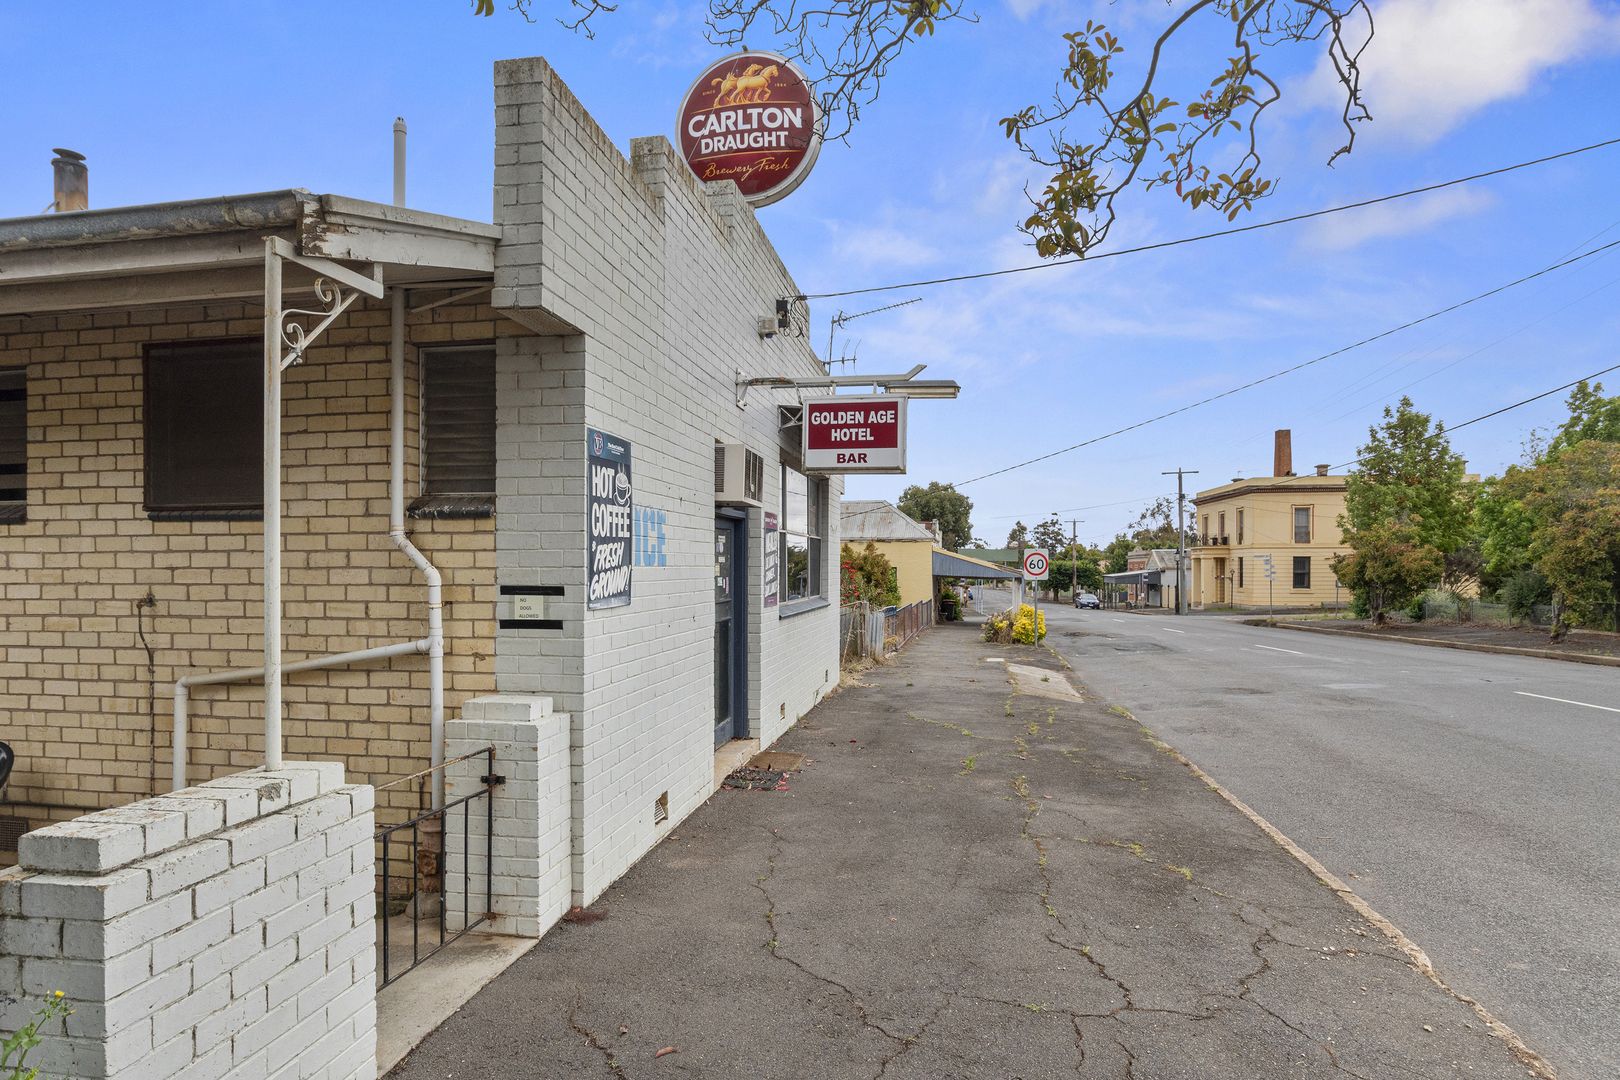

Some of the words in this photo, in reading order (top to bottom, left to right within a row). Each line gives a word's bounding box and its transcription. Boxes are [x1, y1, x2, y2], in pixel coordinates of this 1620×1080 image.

[688, 107, 803, 138] CARLTON
[701, 131, 789, 154] DRAUGHT
[703, 162, 752, 182] Brewery
[754, 157, 790, 174] Fresh
[811, 411, 864, 425] GOLDEN
[868, 410, 895, 423] AGE
[831, 428, 874, 441] HOTEL
[836, 453, 868, 464] BAR
[592, 465, 615, 499] HOT
[592, 503, 630, 538] COFFEE
[634, 507, 667, 567] ICE
[593, 541, 625, 572] FRESH
[1029, 559, 1044, 570] 60
